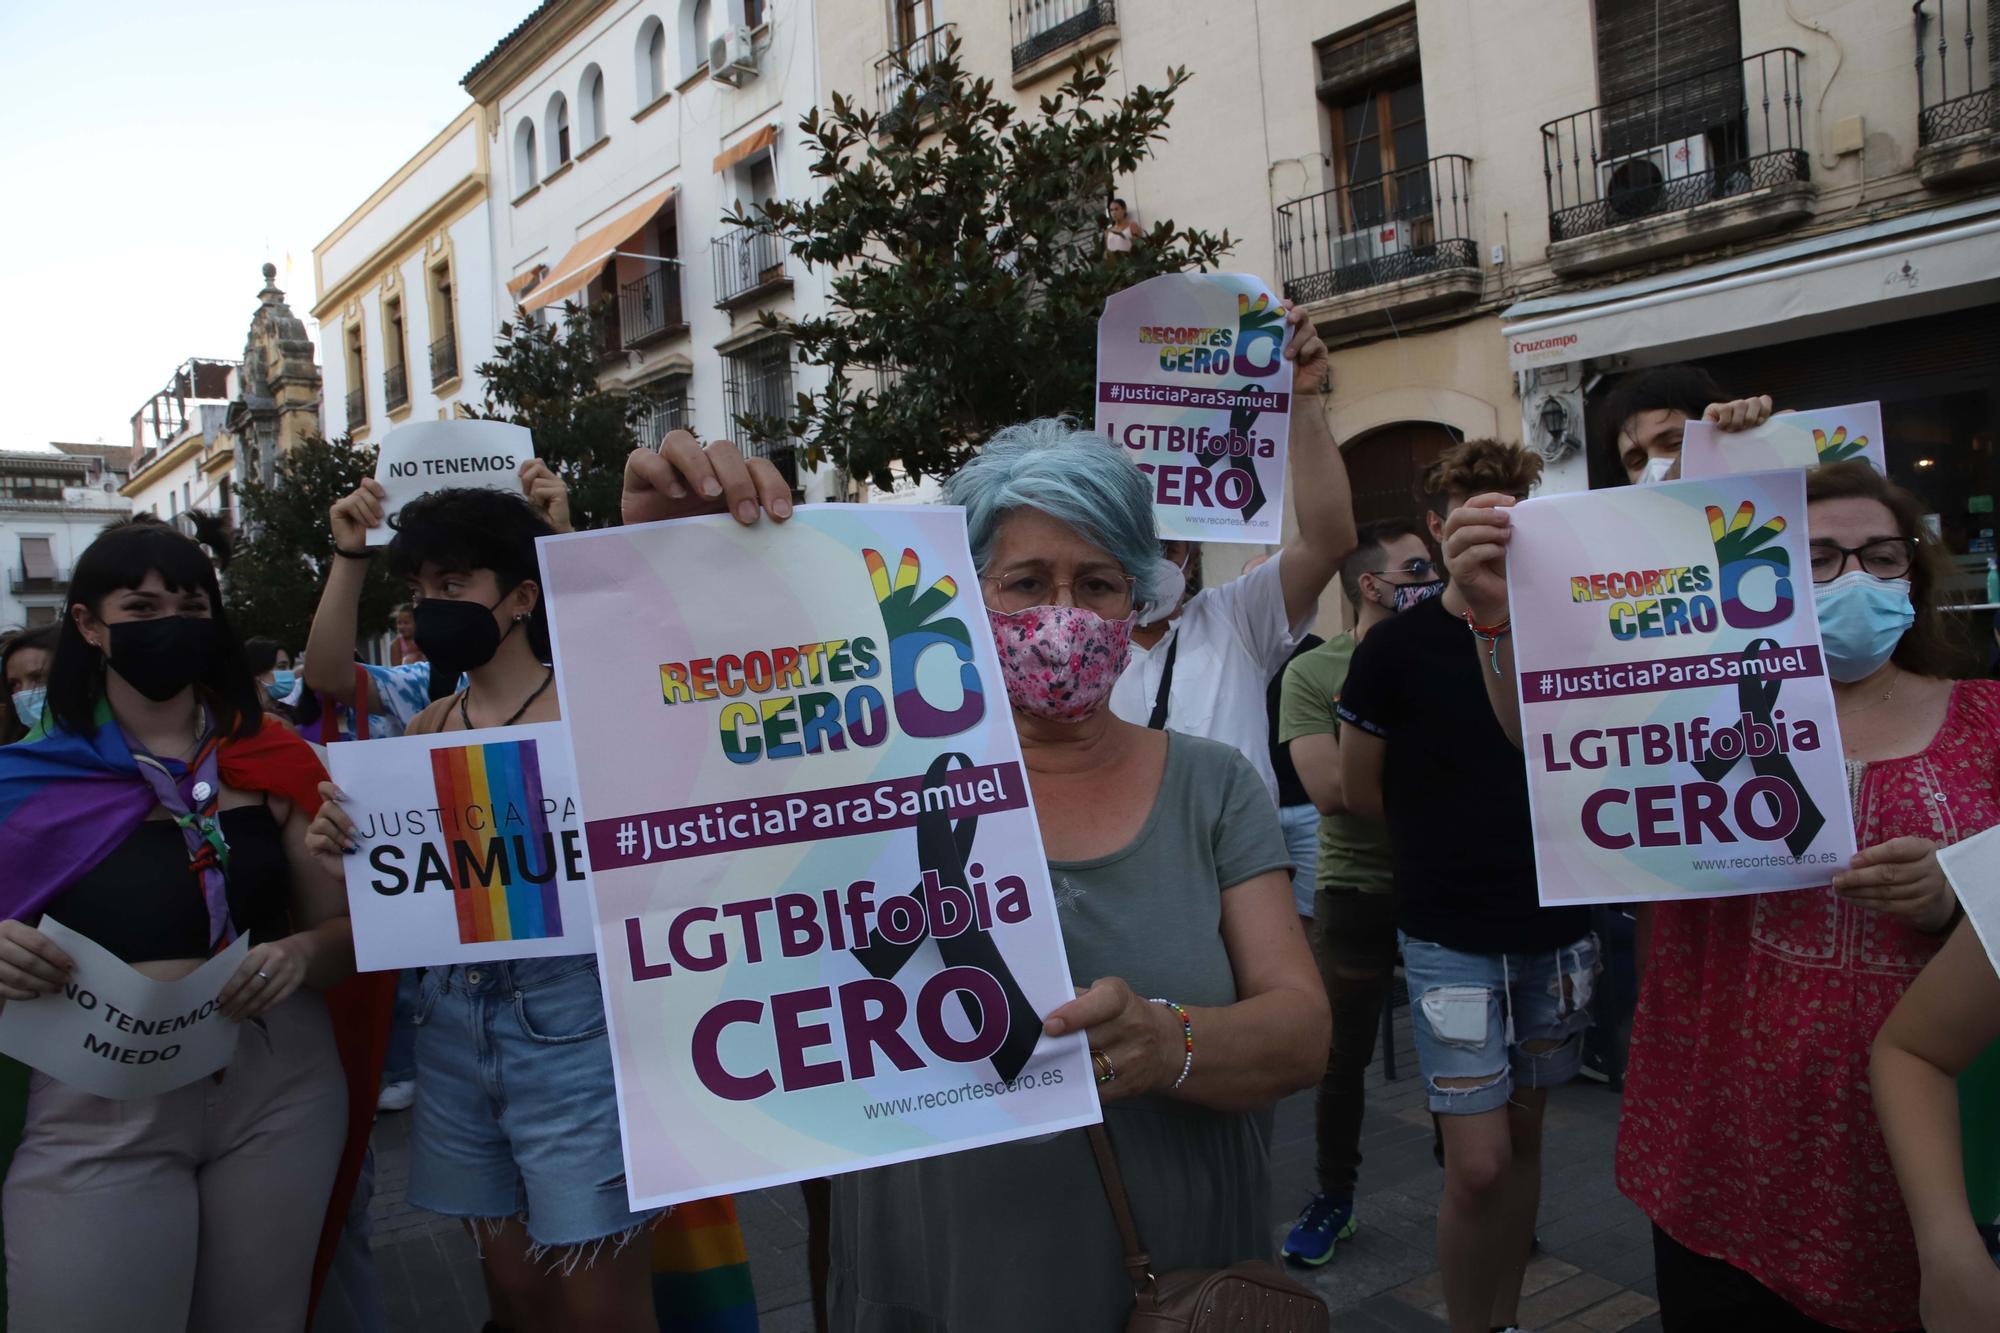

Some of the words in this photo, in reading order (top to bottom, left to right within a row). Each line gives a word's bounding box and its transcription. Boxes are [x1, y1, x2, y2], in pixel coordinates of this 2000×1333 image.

[1139, 326, 1233, 348] RECORTES
[1513, 333, 1578, 354] Cruzcampo
[1159, 346, 1231, 376] CERO
[1110, 384, 1279, 410] #JusticiaParaSamuel
[389, 460, 418, 478] NO
[422, 455, 516, 475] TENEMOS
[1136, 463, 1254, 510] ERO
[1571, 564, 1713, 603] RECORTES
[1609, 595, 1719, 641] CERO
[659, 636, 881, 705] RECORTES
[1539, 648, 1807, 698] #JusticiaParaSamuel
[719, 684, 889, 764] CERO
[1542, 709, 1821, 773] LGTBIfobia
[361, 801, 525, 840] JUSTICIA
[539, 797, 577, 824] PA
[615, 767, 1008, 861] #JusticiaParaSamuel
[1580, 774, 1801, 850] CERO
[369, 829, 586, 896] SAMUE
[624, 862, 1033, 982] LGTBIfobia
[64, 982, 98, 1011] NO
[83, 1032, 182, 1065] MIEDO
[690, 965, 1012, 1102] CERO
[862, 1067, 1064, 1120] www.recortescero.es
